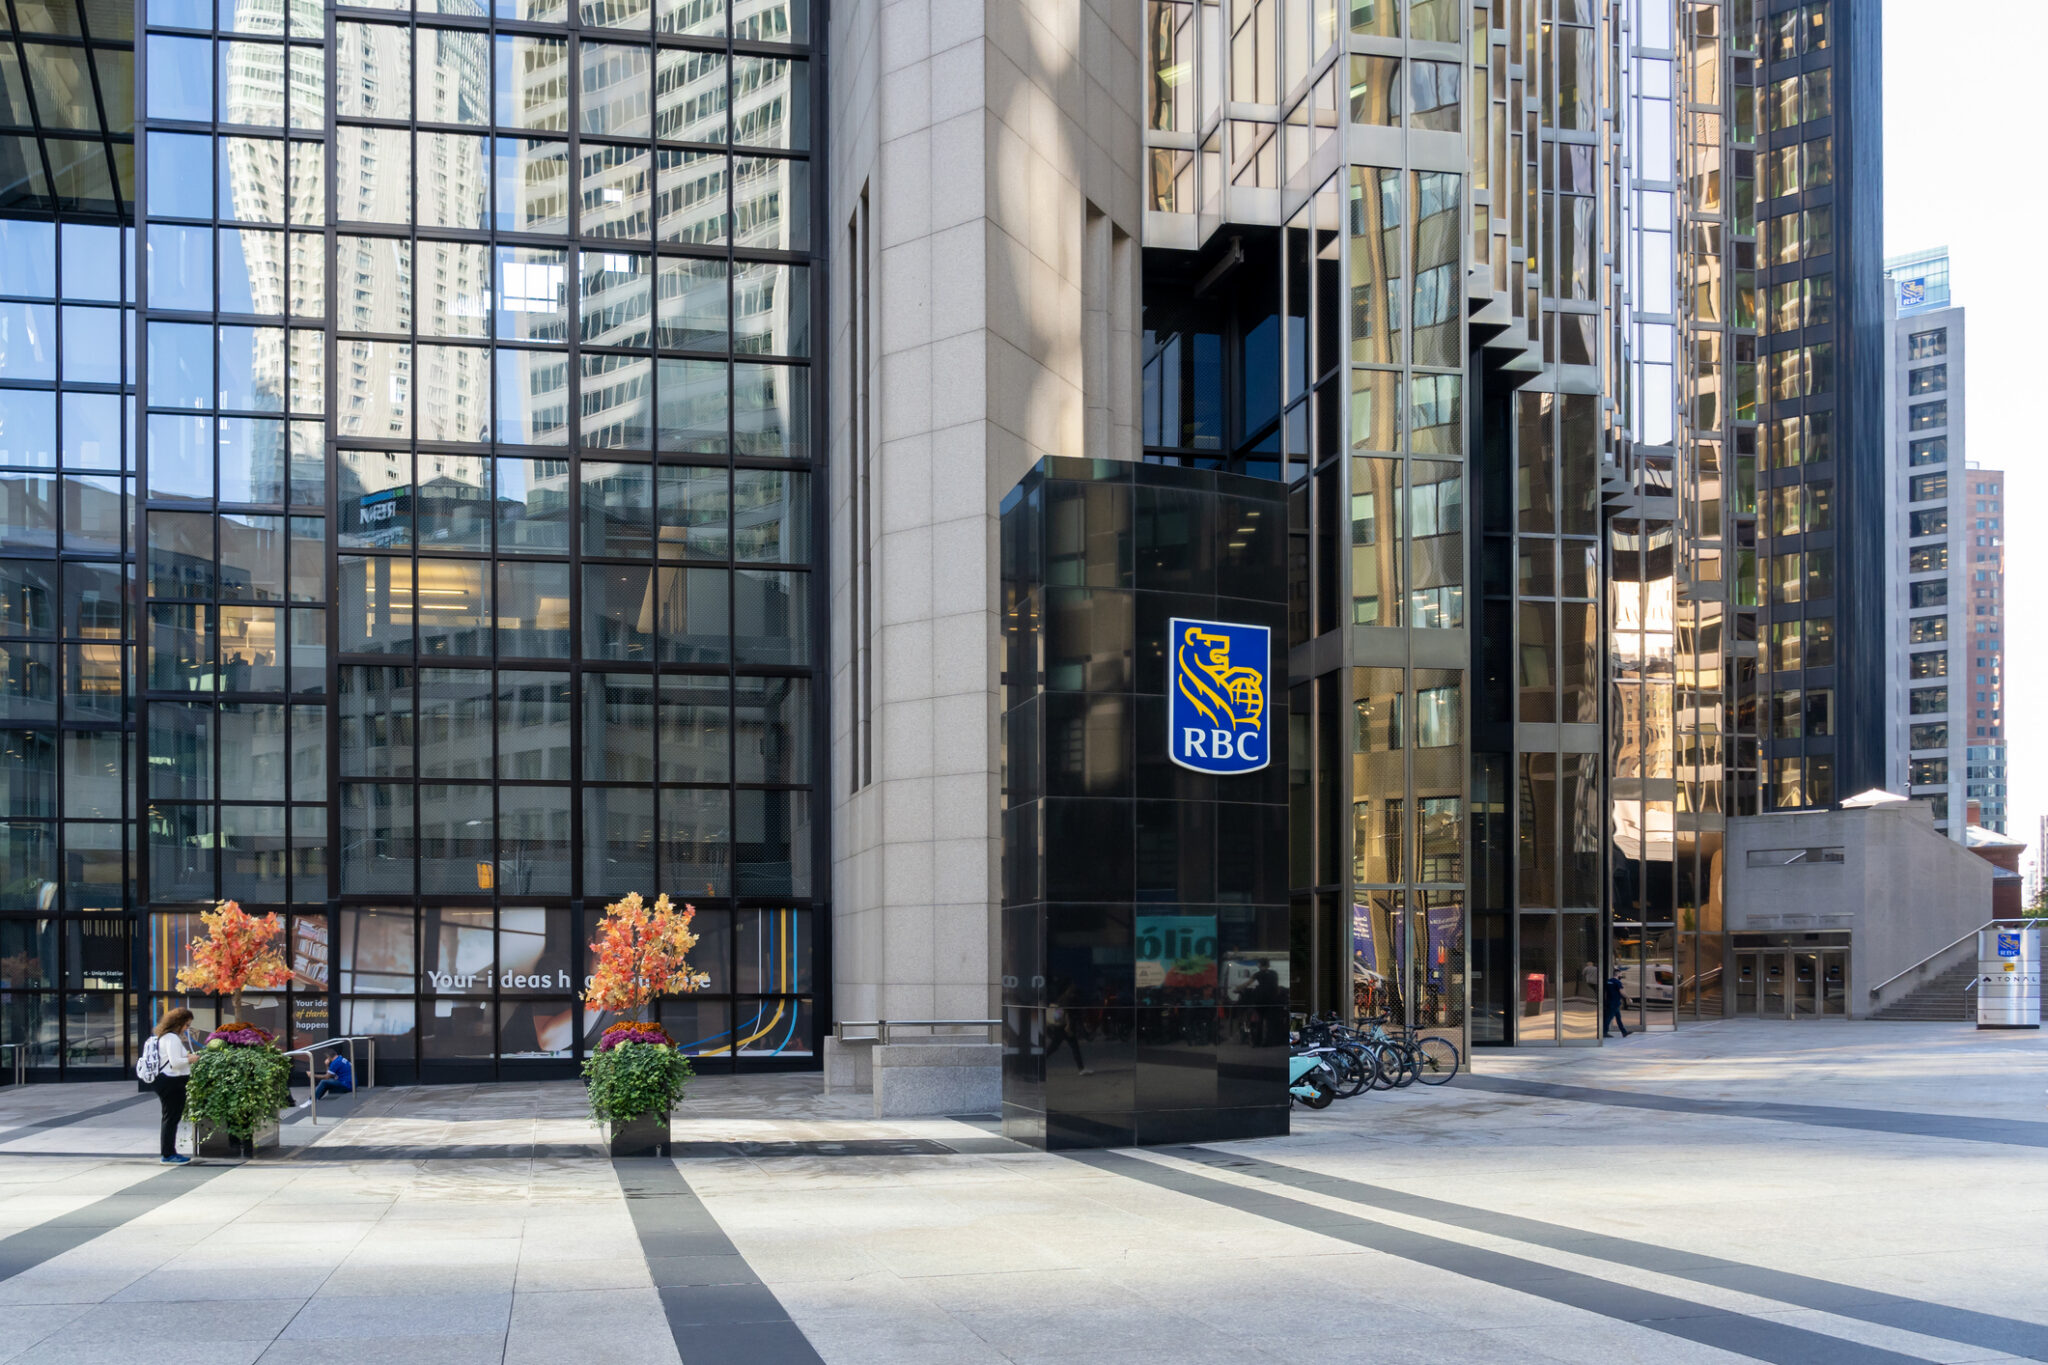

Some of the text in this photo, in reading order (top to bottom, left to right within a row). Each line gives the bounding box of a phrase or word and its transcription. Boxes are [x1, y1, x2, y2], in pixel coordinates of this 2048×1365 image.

[1903, 297, 1922, 305] RBC
[1183, 727, 1259, 761] RBC
[427, 970, 477, 988] Your
[296, 999, 313, 1007] Your
